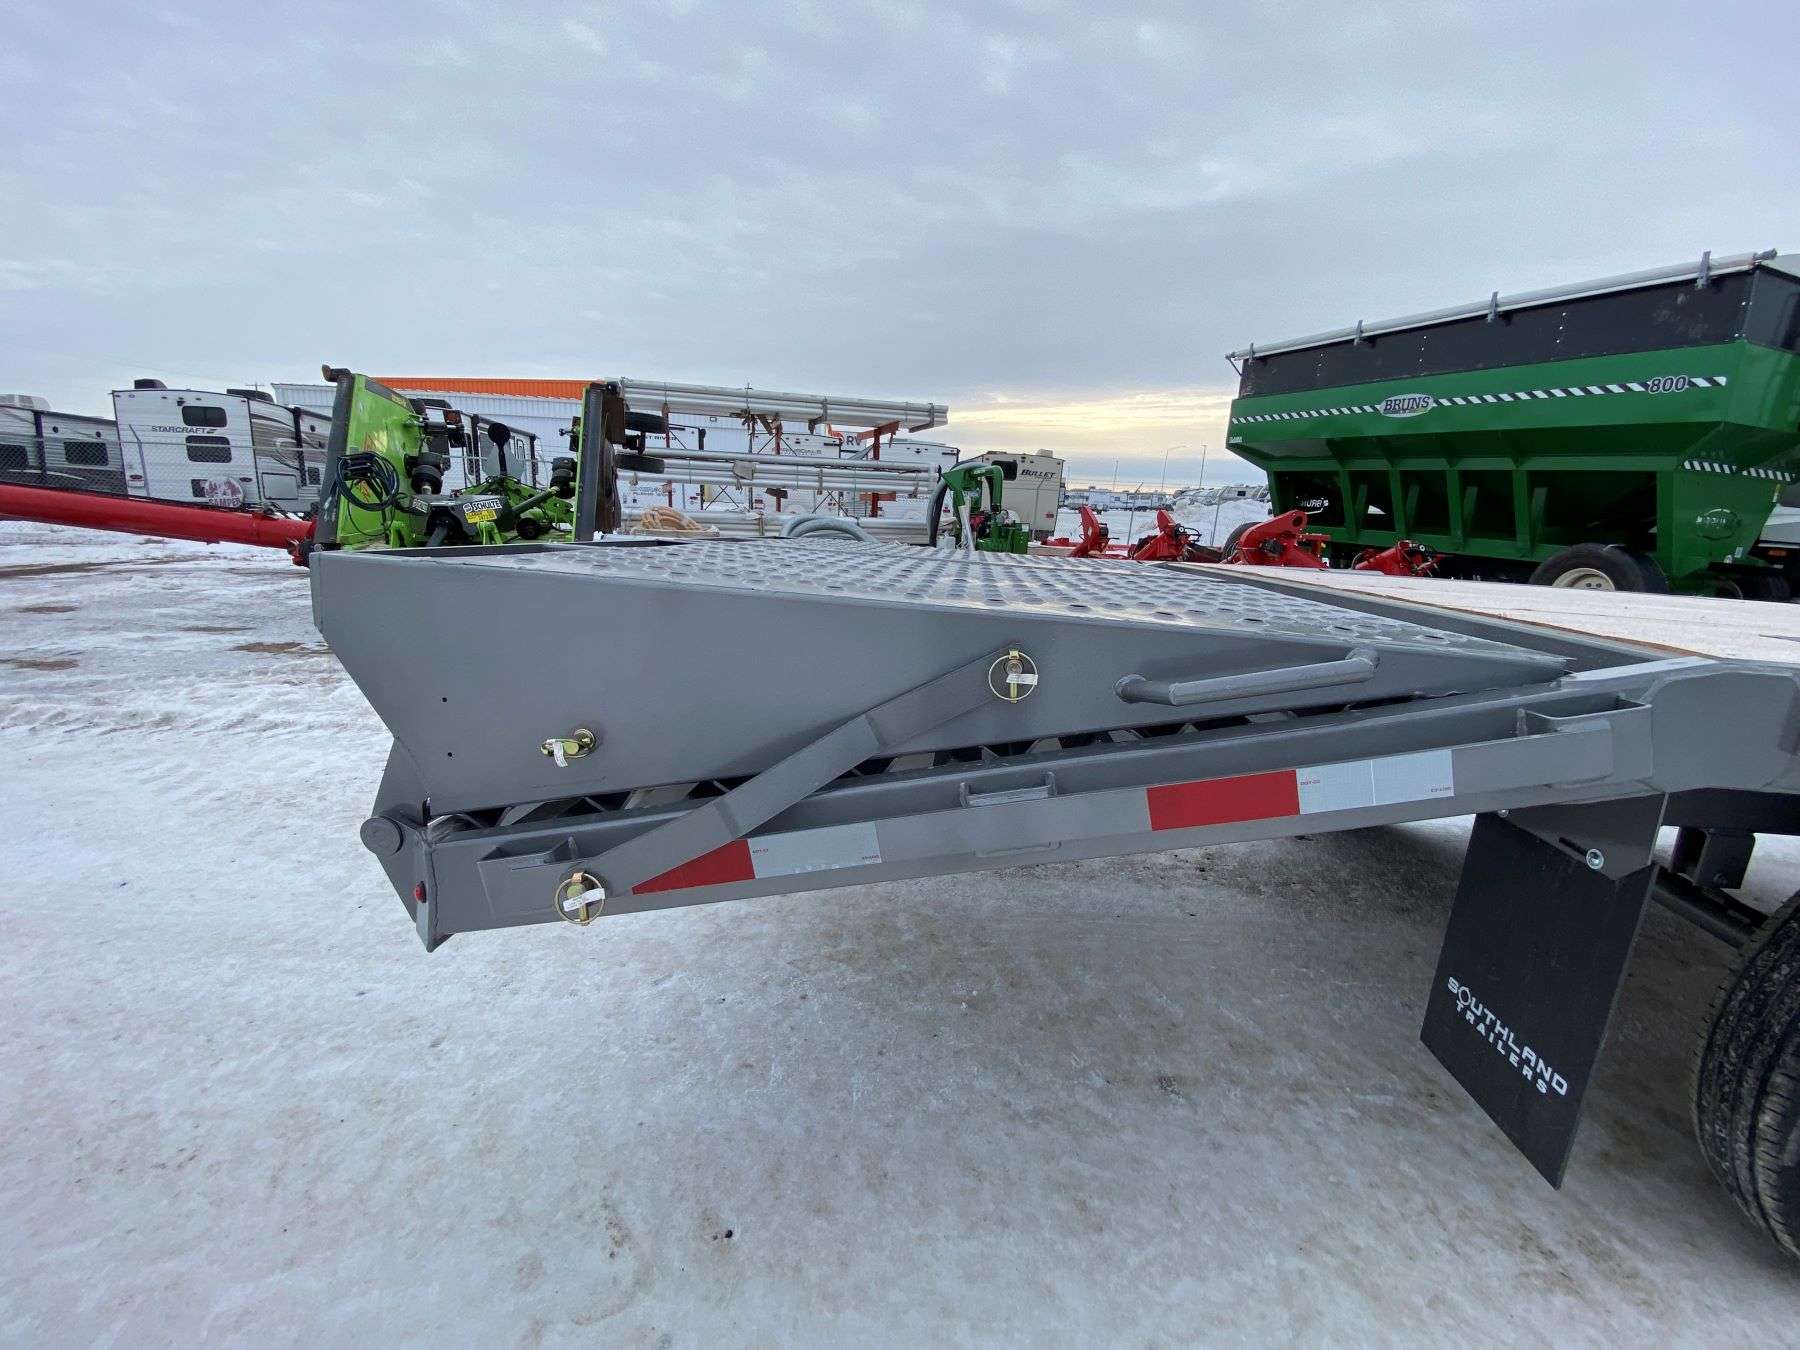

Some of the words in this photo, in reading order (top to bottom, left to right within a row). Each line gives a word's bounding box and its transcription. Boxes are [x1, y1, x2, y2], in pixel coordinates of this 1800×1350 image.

[1649, 375, 1688, 394] 800
[1383, 396, 1431, 411] BRUNS
[152, 425, 207, 434] STARCRAFT
[1021, 469, 1056, 478] BULLET
[472, 500, 502, 511] SCHULTE
[1447, 976, 1568, 1096] SOUTHLAND
[1456, 999, 1547, 1094] TRAILERS
